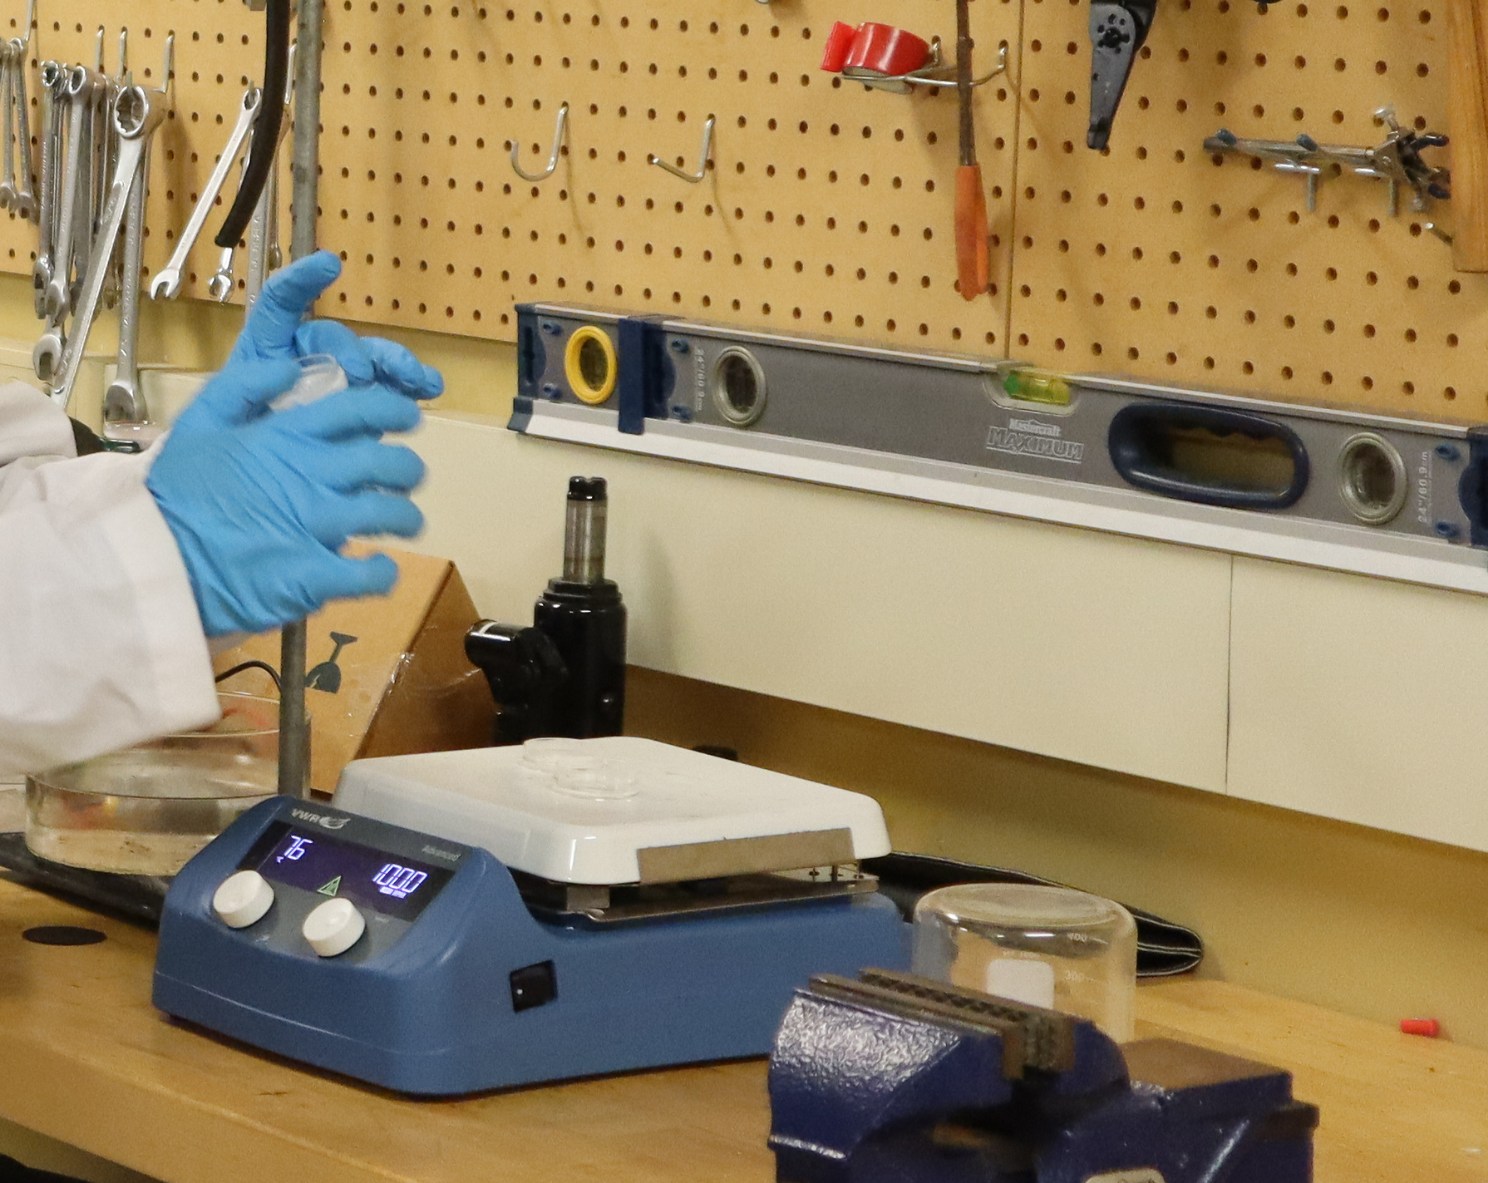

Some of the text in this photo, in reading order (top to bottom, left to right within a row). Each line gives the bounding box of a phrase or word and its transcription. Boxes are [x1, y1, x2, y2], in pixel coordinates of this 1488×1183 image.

[1009, 418, 1062, 437] Mastercraft
[986, 425, 1084, 460] MAXIMUM
[291, 808, 321, 824] VWR
[284, 834, 314, 861] 76
[371, 863, 429, 894] 1000
